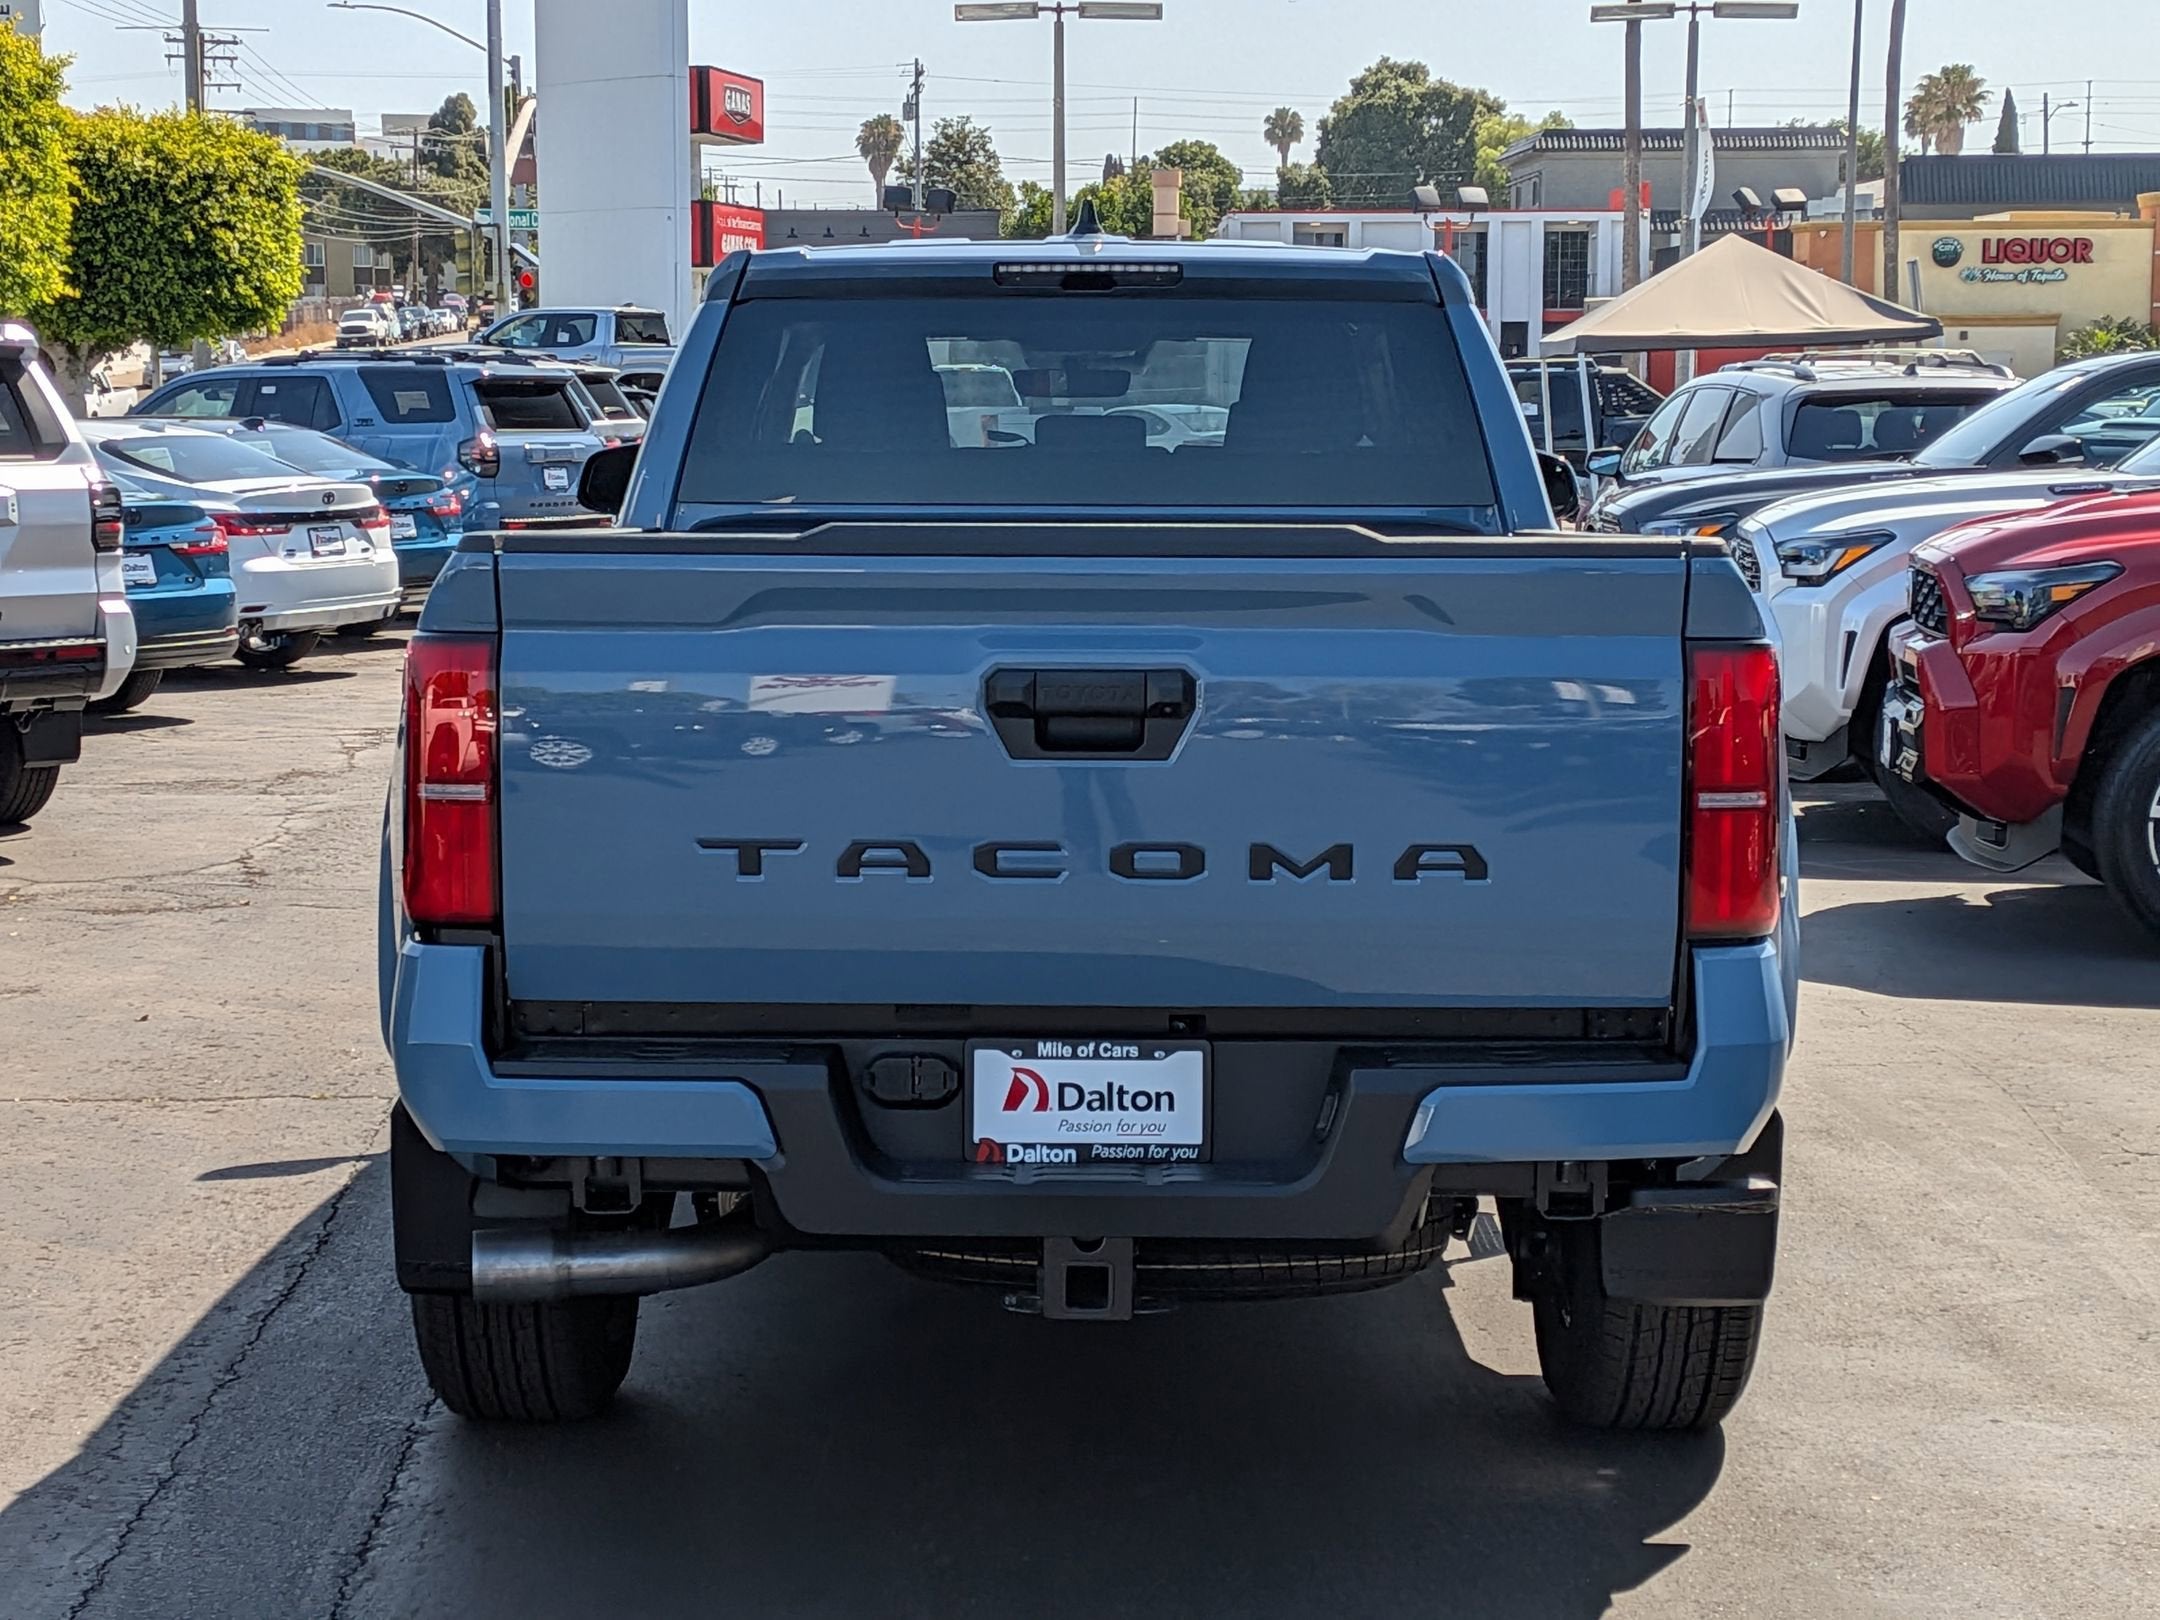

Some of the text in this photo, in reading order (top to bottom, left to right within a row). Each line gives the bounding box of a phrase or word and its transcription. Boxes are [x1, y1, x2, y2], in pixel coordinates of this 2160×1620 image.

[725, 89, 751, 115] GANAS
[1982, 237, 2094, 264] LIQUOR
[2017, 269, 2029, 283] of
[694, 837, 1491, 883] TACOMA
[1037, 1041, 1139, 1059] Mile of Cars
[1057, 1081, 1175, 1112] Dalton
[1058, 1119, 1167, 1135] Passion for you
[1006, 1144, 1199, 1163] Dalton Passion for you
